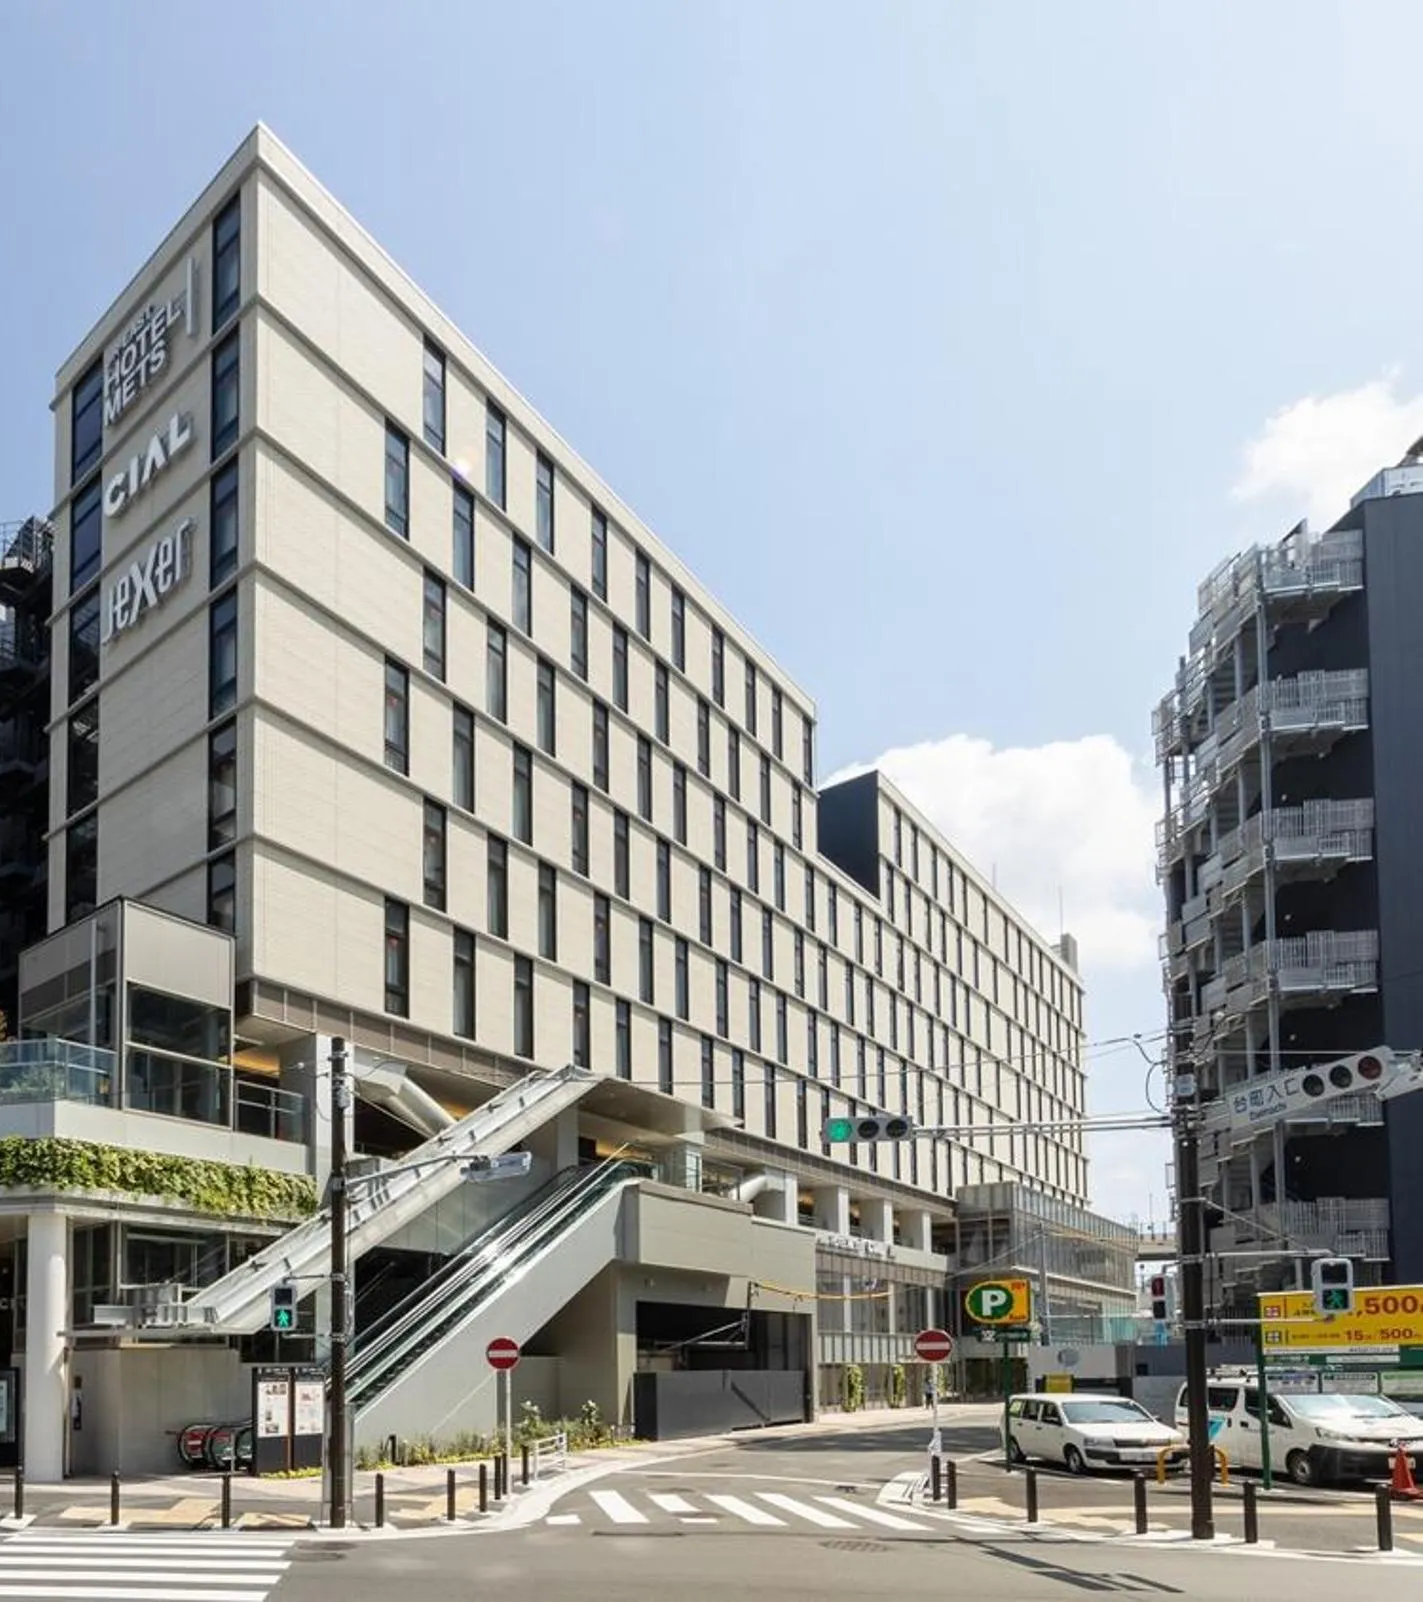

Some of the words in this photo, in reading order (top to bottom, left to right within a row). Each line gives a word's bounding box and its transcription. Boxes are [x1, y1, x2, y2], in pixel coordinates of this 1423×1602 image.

[103, 301, 181, 397] HOTEL
[104, 339, 166, 427] METS
[104, 413, 191, 518] CIAL
[982, 1290, 1007, 1316] P
